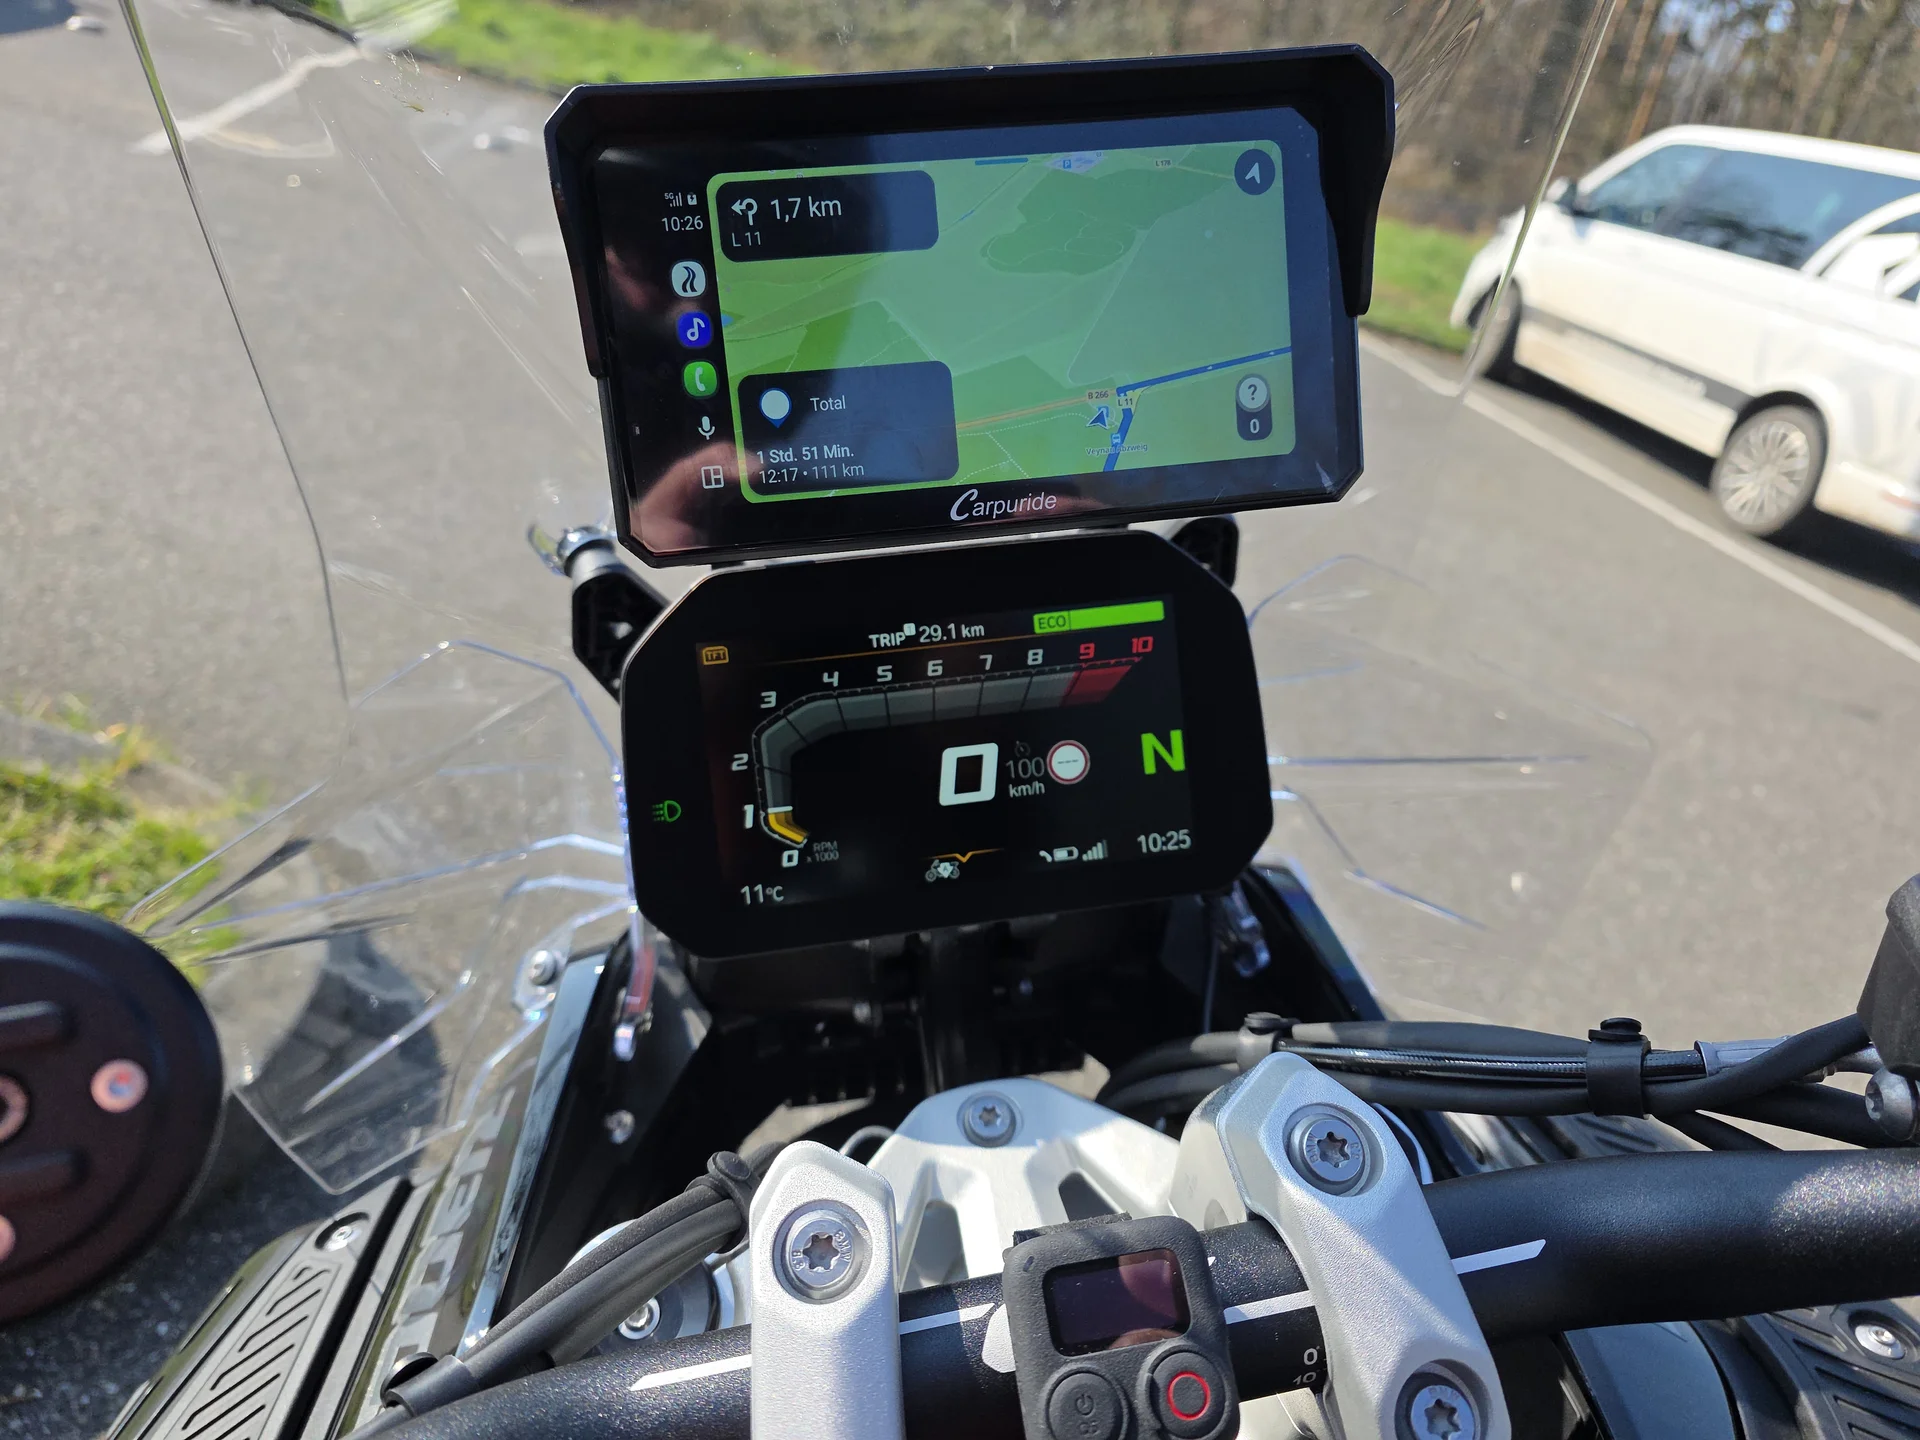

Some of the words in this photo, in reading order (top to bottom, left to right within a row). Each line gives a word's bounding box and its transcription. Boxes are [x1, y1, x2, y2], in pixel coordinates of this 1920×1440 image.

[664, 192, 674, 200] 5G
[770, 197, 802, 223] 1,7
[808, 196, 842, 217] km
[661, 215, 704, 232] 10:26
[731, 233, 741, 247] L
[744, 231, 762, 246] 11
[809, 395, 846, 412] Total
[1087, 392, 1094, 400] B
[1095, 390, 1109, 399] 266
[1249, 418, 1260, 434] 0
[756, 450, 764, 464] 1
[769, 448, 798, 463] Std.
[802, 446, 819, 460] 51
[823, 443, 855, 459] Min.
[758, 466, 798, 485] 12:17
[811, 463, 838, 480] 111
[842, 462, 865, 477] km
[949, 488, 1058, 522] Carpuride
[1038, 614, 1067, 630] ECO
[868, 631, 906, 648] TRIP
[919, 622, 956, 643] 29.1
[961, 623, 985, 638] km
[1079, 643, 1095, 659] 9
[1131, 636, 1154, 654] 10
[705, 650, 727, 662] TFT
[979, 654, 993, 670] 7
[1027, 648, 1044, 666] 8
[876, 665, 893, 682] 5
[927, 659, 943, 677] 6
[822, 671, 839, 687] 4
[760, 691, 777, 709] 3
[1140, 729, 1186, 775] N
[731, 753, 749, 771] 2
[1005, 756, 1046, 780] 100
[939, 742, 999, 807] 0
[1008, 780, 1046, 798] km/h
[743, 804, 754, 829] 1
[813, 840, 838, 852] RPM
[1137, 829, 1192, 854] 10:25
[782, 849, 799, 868] 0
[814, 850, 840, 862] 1000
[1292, 1371, 1317, 1386] 10
